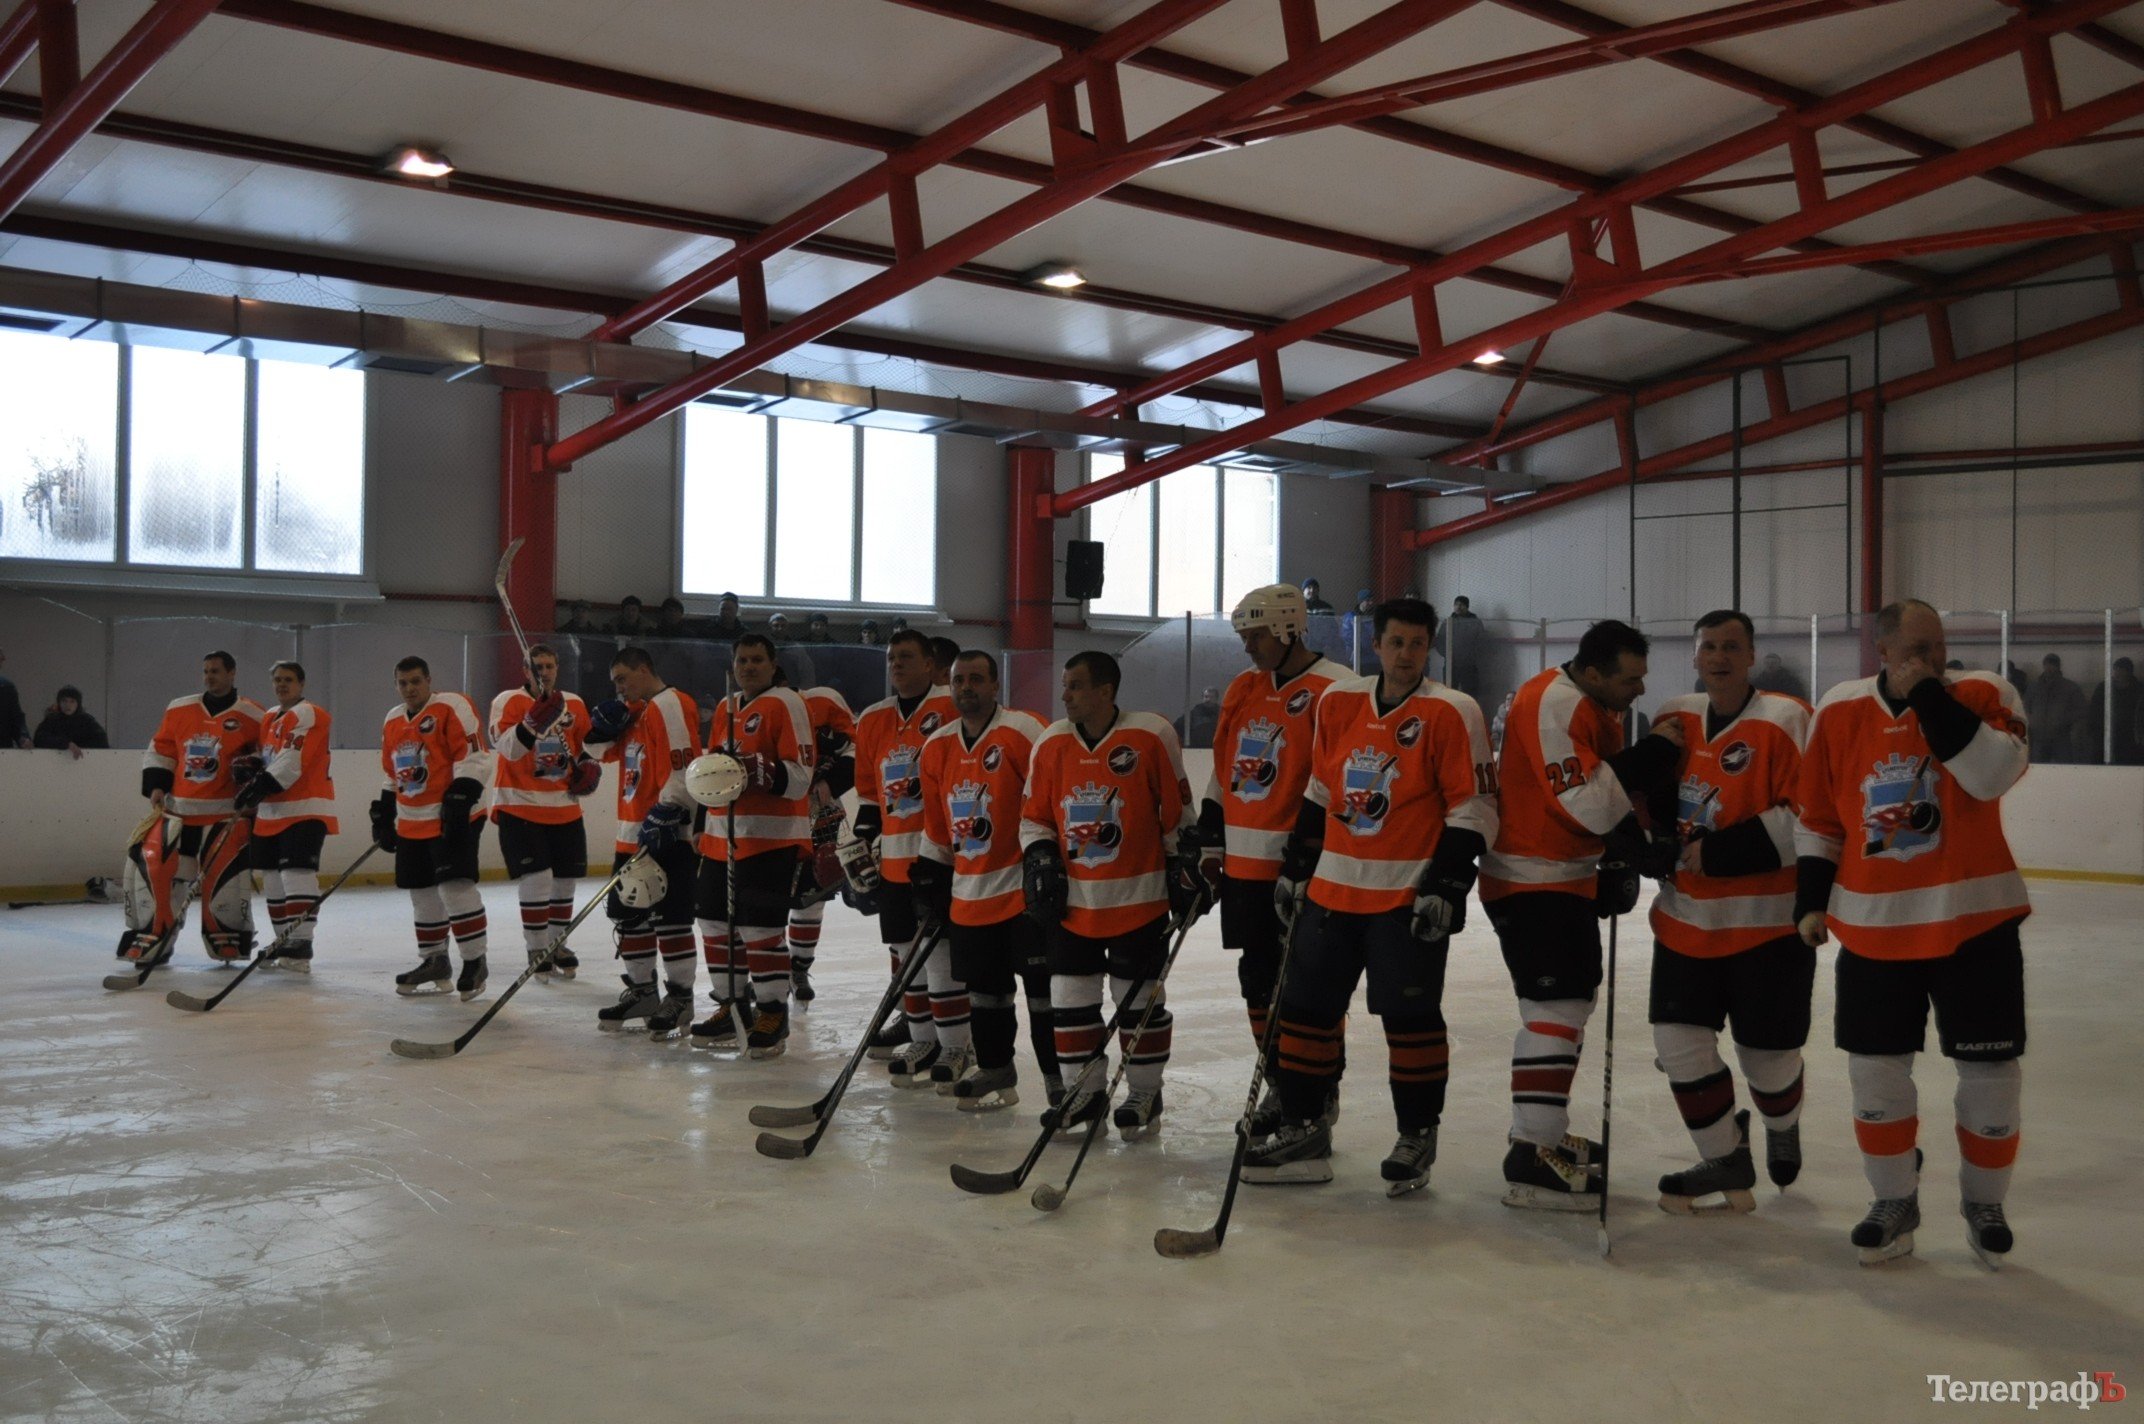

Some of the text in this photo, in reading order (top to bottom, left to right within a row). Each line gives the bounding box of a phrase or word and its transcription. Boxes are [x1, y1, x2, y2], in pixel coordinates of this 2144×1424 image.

[1475, 762, 1498, 794] 11
[1545, 756, 1586, 796] 22
[1955, 1040, 2014, 1051] EASTON
